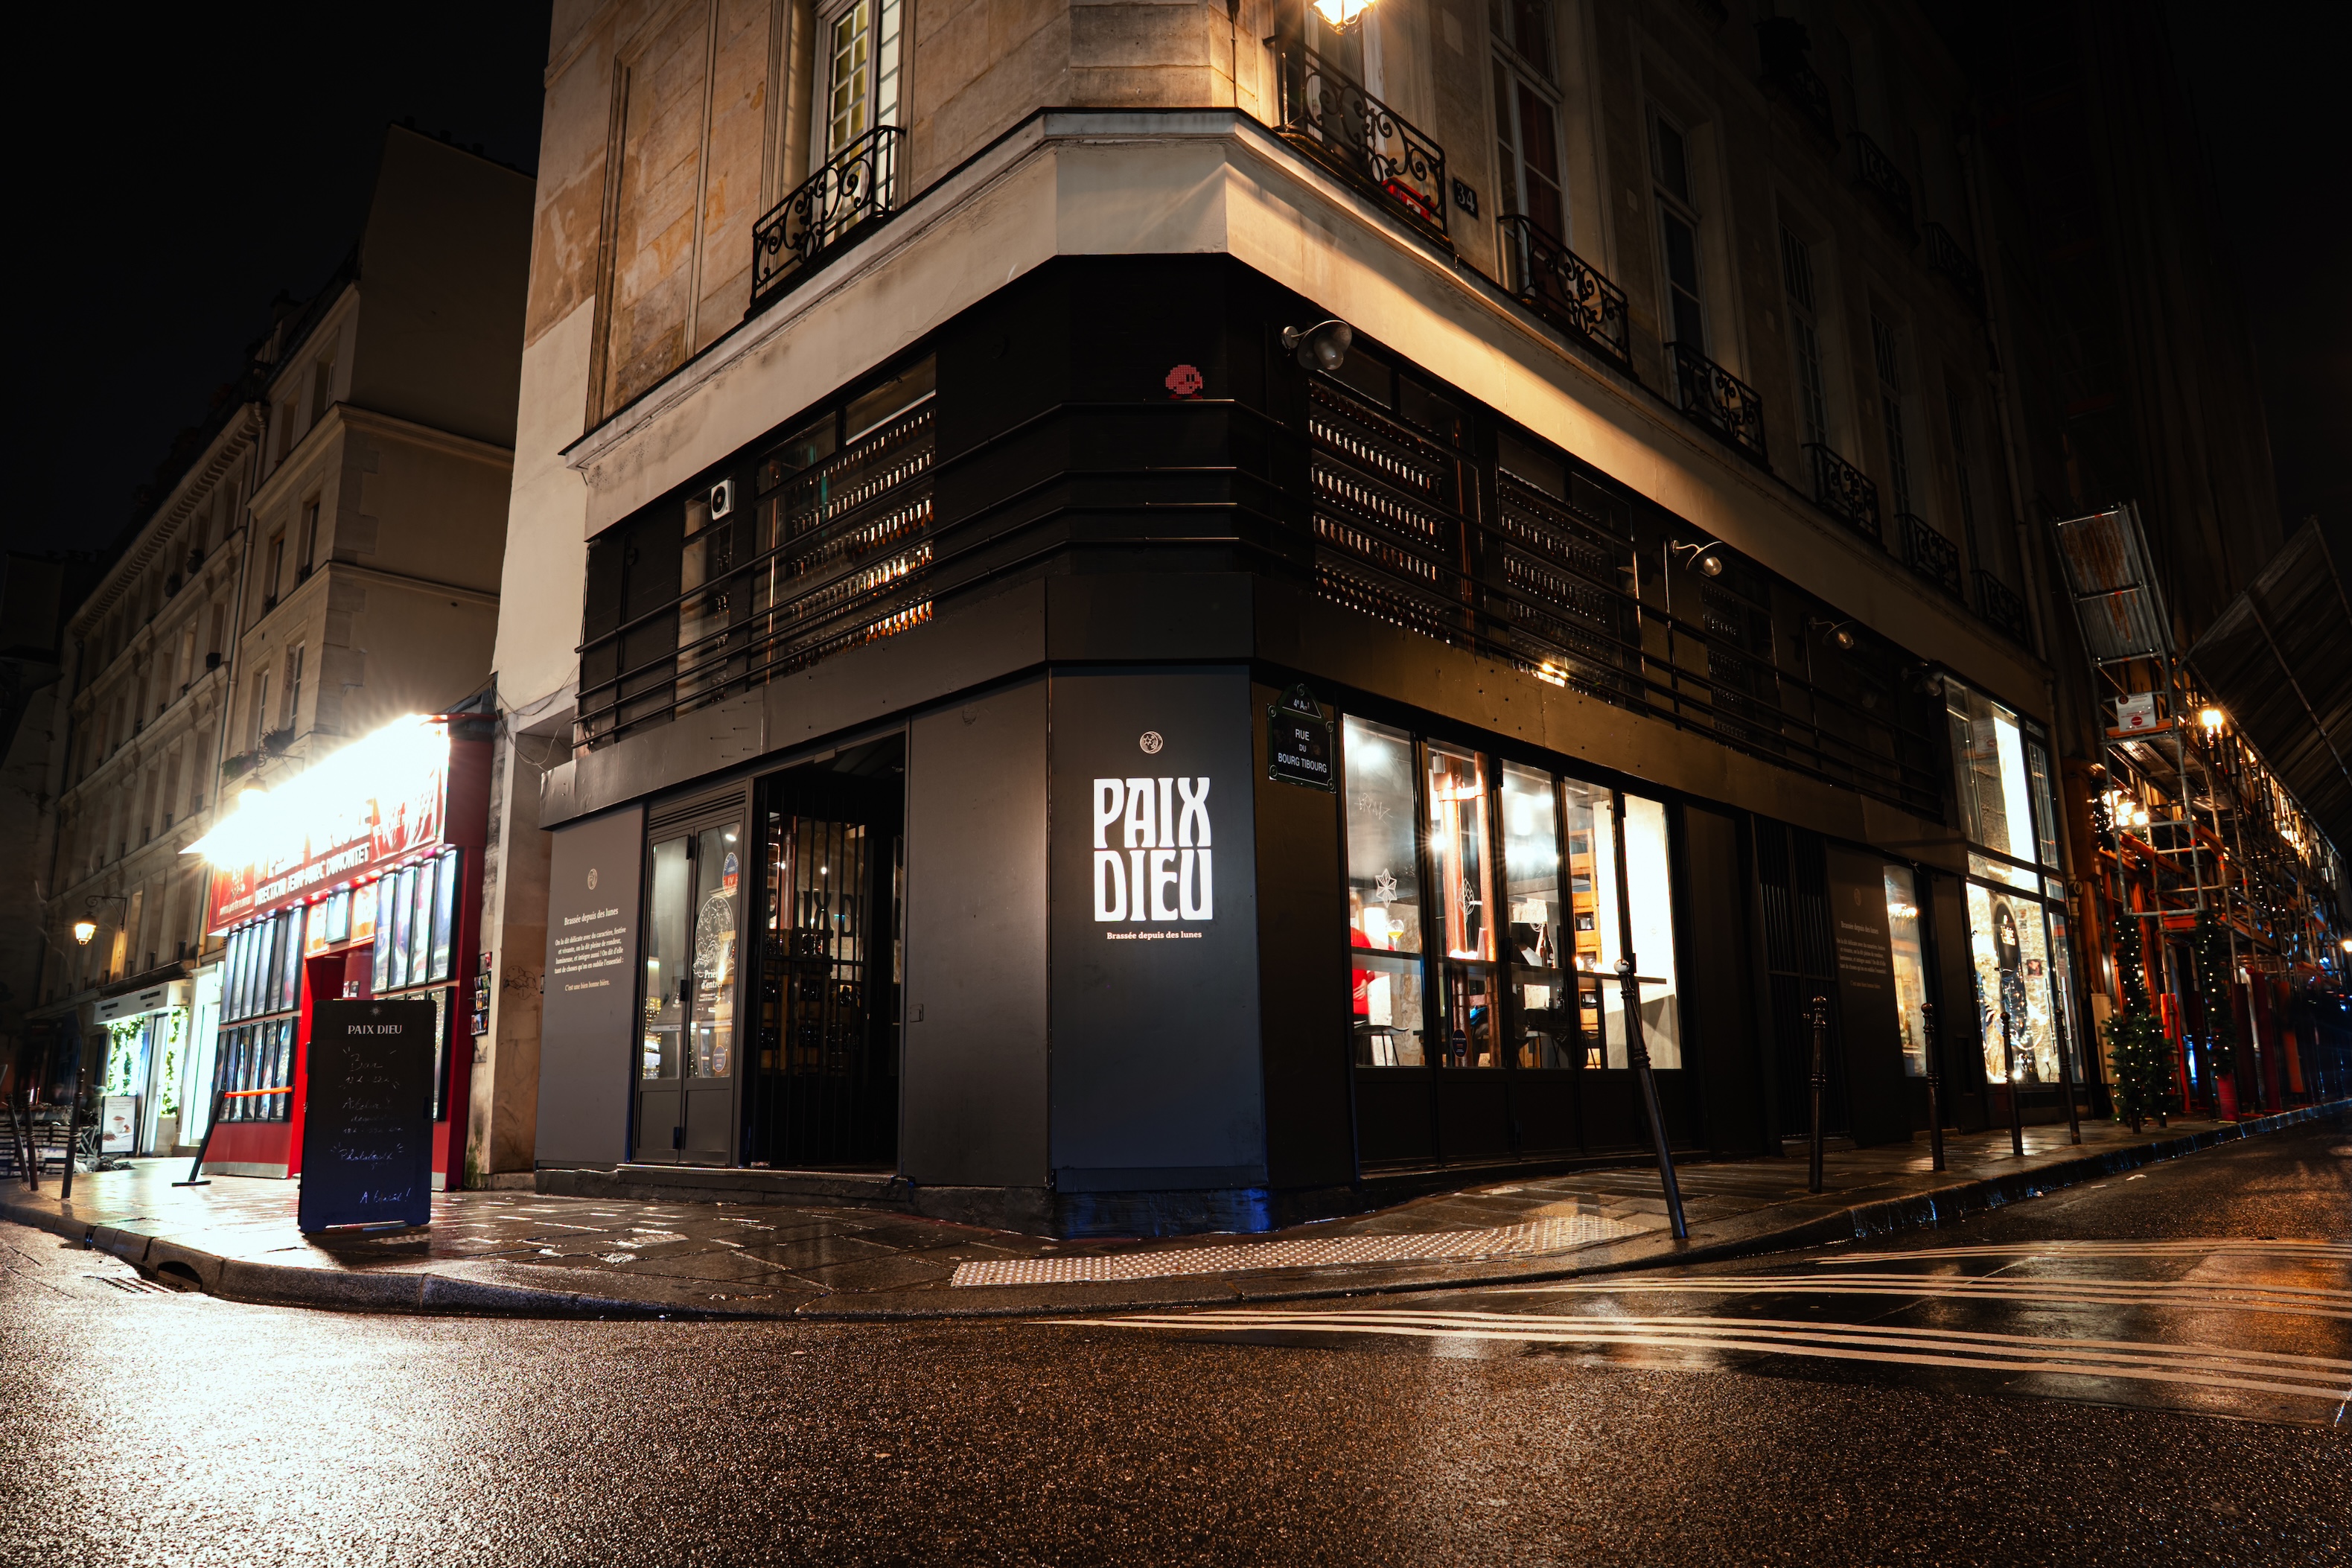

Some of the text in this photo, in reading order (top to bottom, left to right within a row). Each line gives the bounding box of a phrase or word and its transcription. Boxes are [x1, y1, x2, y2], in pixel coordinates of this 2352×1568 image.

[1456, 183, 1474, 212] 34
[1295, 729, 1310, 741] RUE
[1298, 744, 1307, 753] DU
[1278, 753, 1328, 773] BOURG TIBOURG
[1094, 777, 1211, 849] PAIX
[255, 877, 287, 906] DIRECTION
[326, 842, 371, 876] DUMONTET
[727, 876, 734, 886] IV
[1094, 849, 1214, 922] DIEU
[564, 914, 581, 925] Brassée
[581, 911, 596, 923] depuis
[605, 908, 619, 917] lunes
[1106, 931, 1137, 940] Brassée
[1138, 931, 1164, 941] depuis
[348, 1024, 403, 1034] PAIX DIEU
